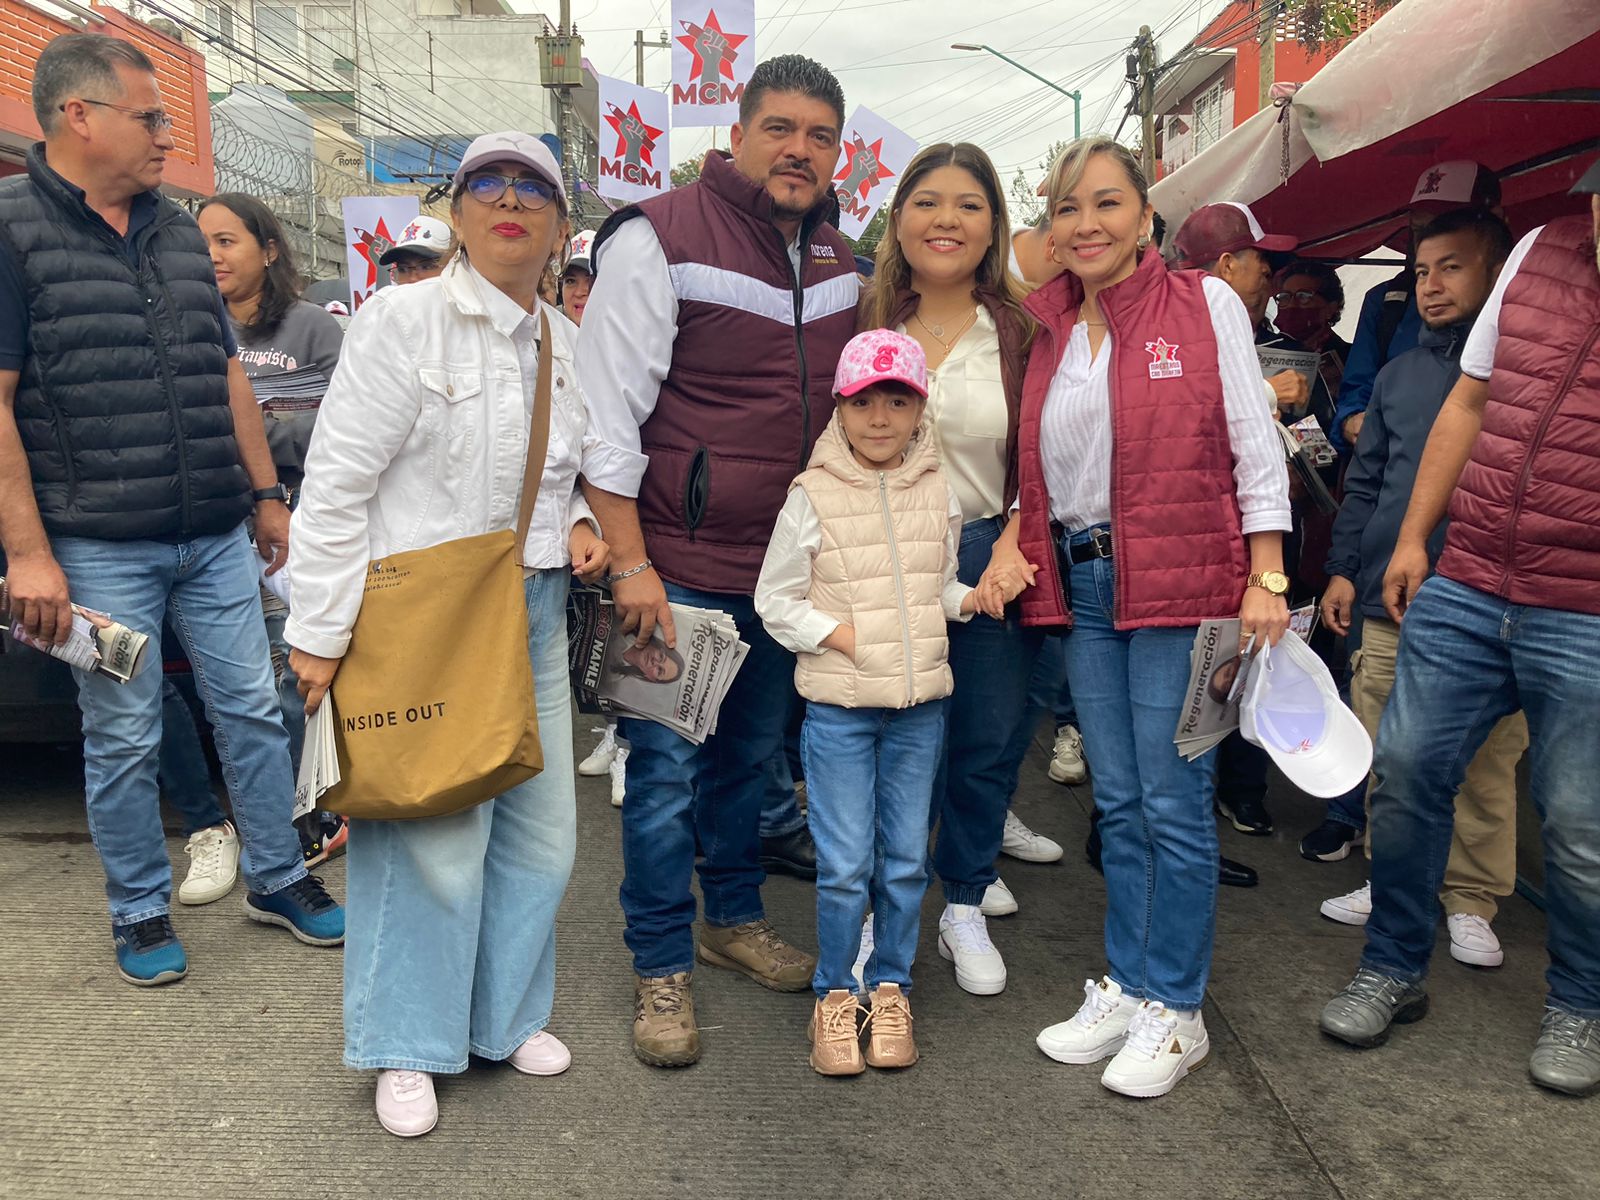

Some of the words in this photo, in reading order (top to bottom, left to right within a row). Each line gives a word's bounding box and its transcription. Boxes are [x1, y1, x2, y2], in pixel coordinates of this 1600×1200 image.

[673, 82, 745, 105] MCM
[600, 156, 662, 189] MCM
[834, 186, 871, 222] CM
[584, 639, 604, 688] NAHLE
[679, 621, 712, 723] Regeneración
[1181, 626, 1218, 734] Regeneración
[343, 711, 398, 733] INSIDE
[406, 702, 446, 723] OUT
